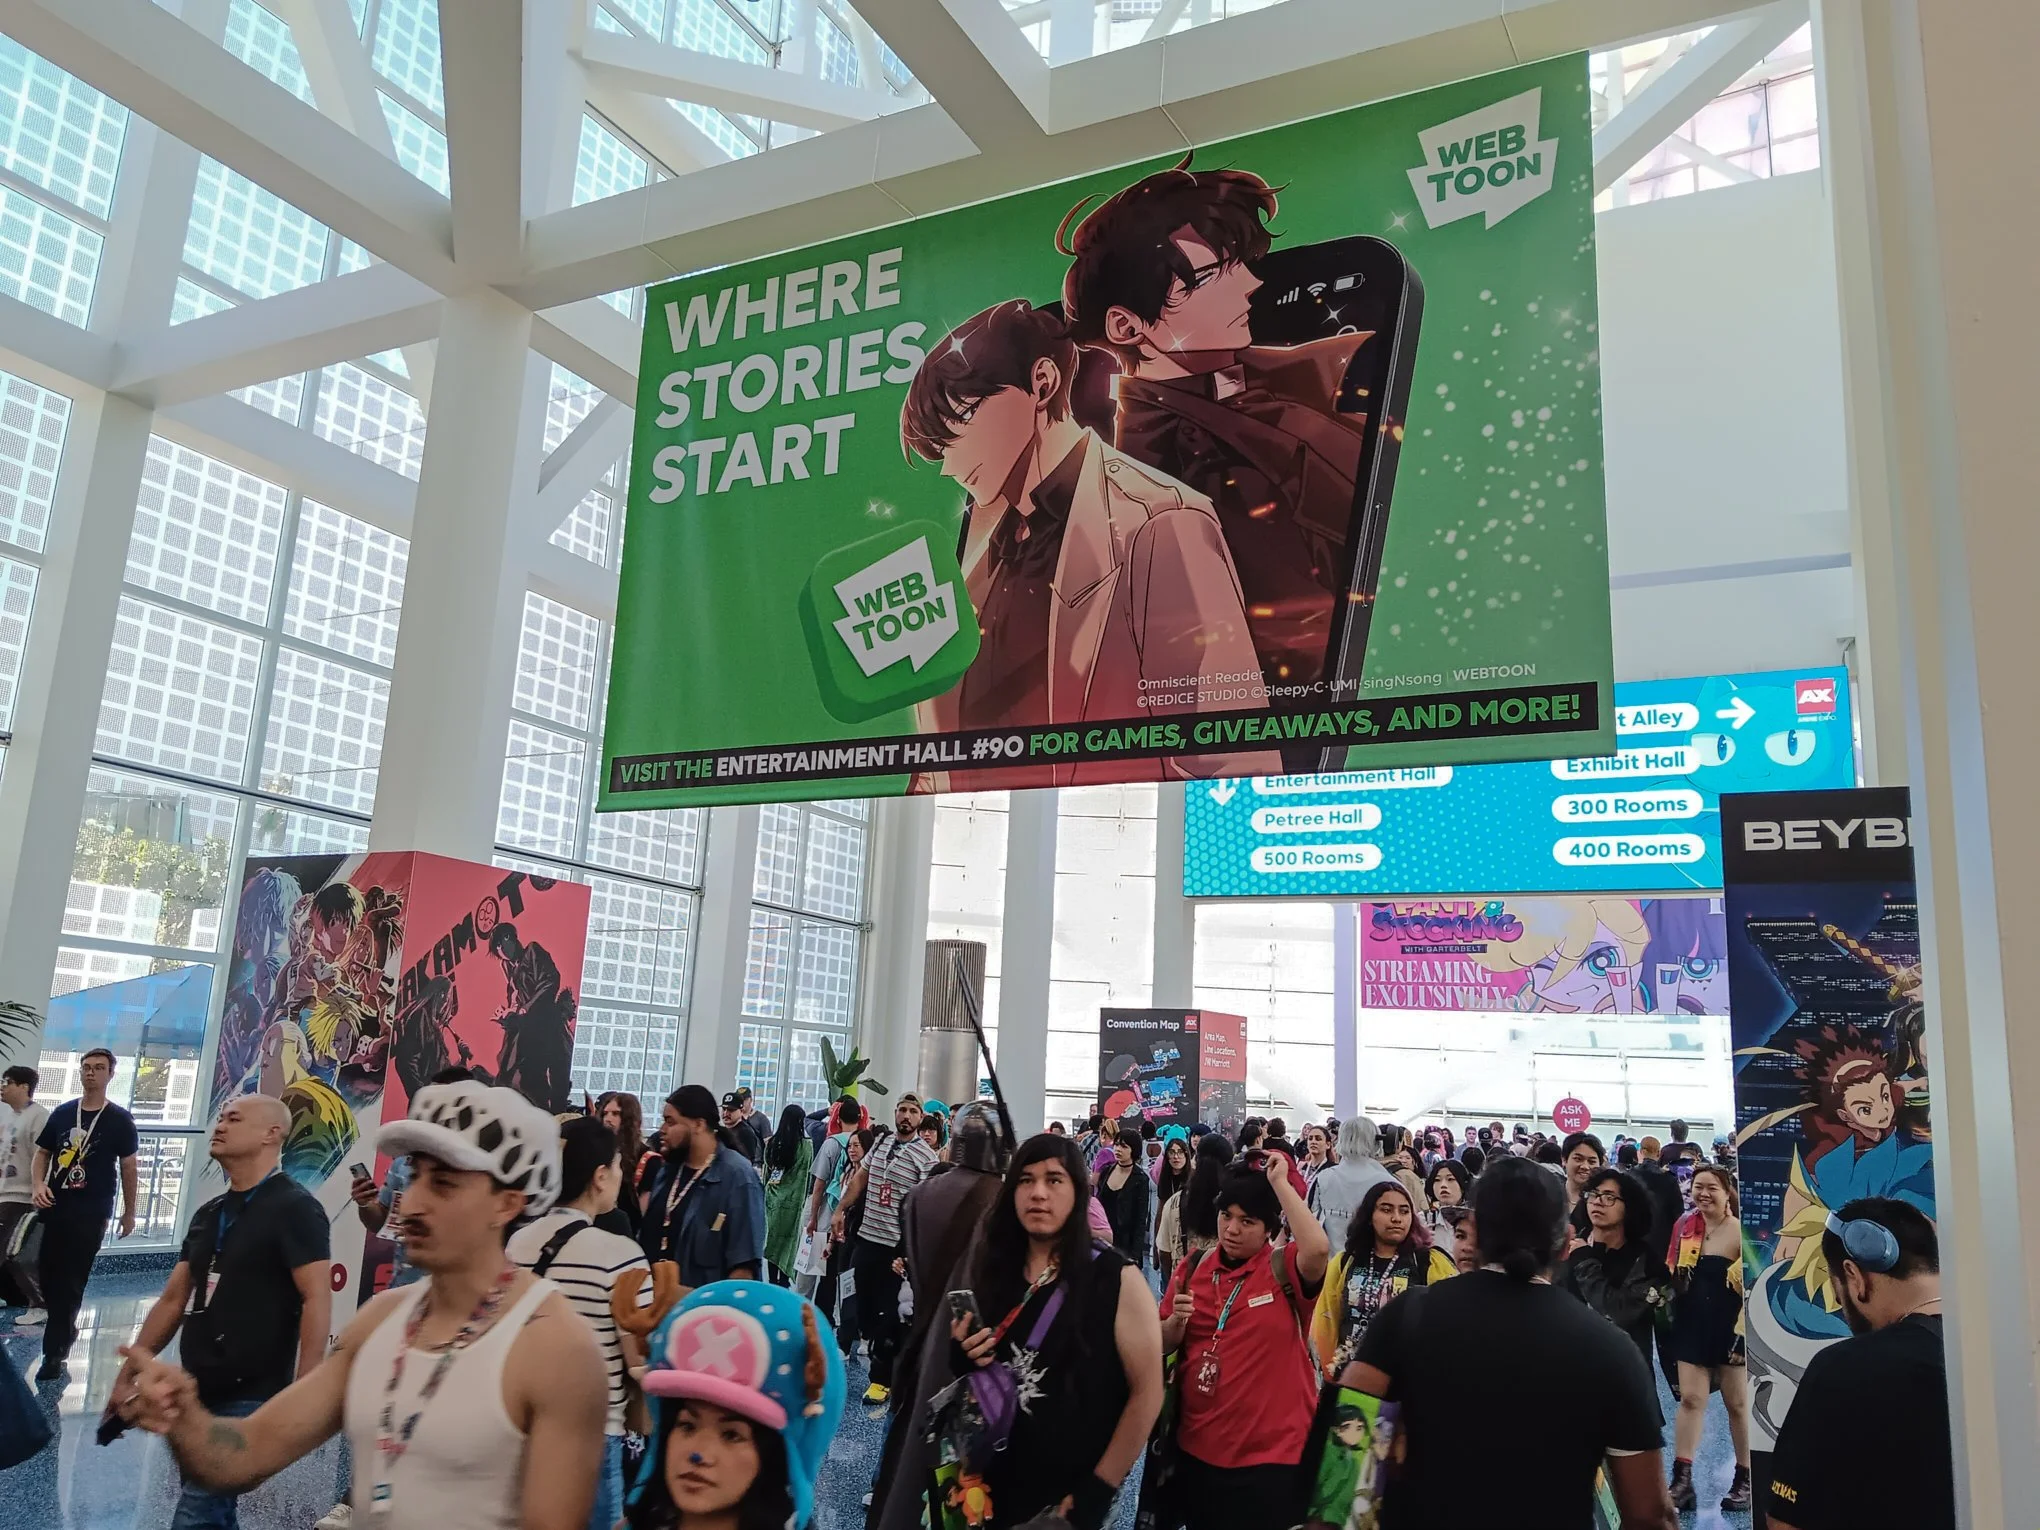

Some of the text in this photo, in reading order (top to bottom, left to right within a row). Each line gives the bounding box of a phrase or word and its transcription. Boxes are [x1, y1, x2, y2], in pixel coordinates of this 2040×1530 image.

[1437, 124, 1526, 168] WEB
[1427, 152, 1541, 203] TOON
[664, 247, 903, 353] WHERE
[655, 321, 927, 429] STORIES
[649, 413, 855, 503] START
[854, 572, 927, 617] WEB
[853, 596, 947, 651] TOON
[1137, 669, 1264, 691] Omniscient Reader
[1197, 688, 1248, 703] STUDIO
[1453, 663, 1536, 681] WEBTOON
[1798, 688, 1834, 704] AX
[1632, 710, 1684, 728] Alley
[619, 694, 1580, 784] VISIT THE ENTERTAINMENT HALL #90 FOR GAMES, GIVEAWAYS, AND MORE!
[1566, 751, 1686, 773] Exhibit Hall
[1264, 767, 1436, 788] Entertainment Hall
[1264, 809, 1363, 827] Petree Hall
[1568, 797, 1688, 815] 300 Rooms
[1744, 817, 1912, 851] BEYB
[1264, 850, 1364, 866] 500 Rooms
[1569, 840, 1692, 858] 400 Rooms
[1370, 912, 1524, 942] STOCKING
[1364, 960, 1492, 984] STREAMING
[1365, 984, 1507, 1009] EXCLUSIVELY
[1106, 1018, 1180, 1031] Convention Map
[1560, 1105, 1583, 1115] ASK
[1564, 1118, 1581, 1127] ME
